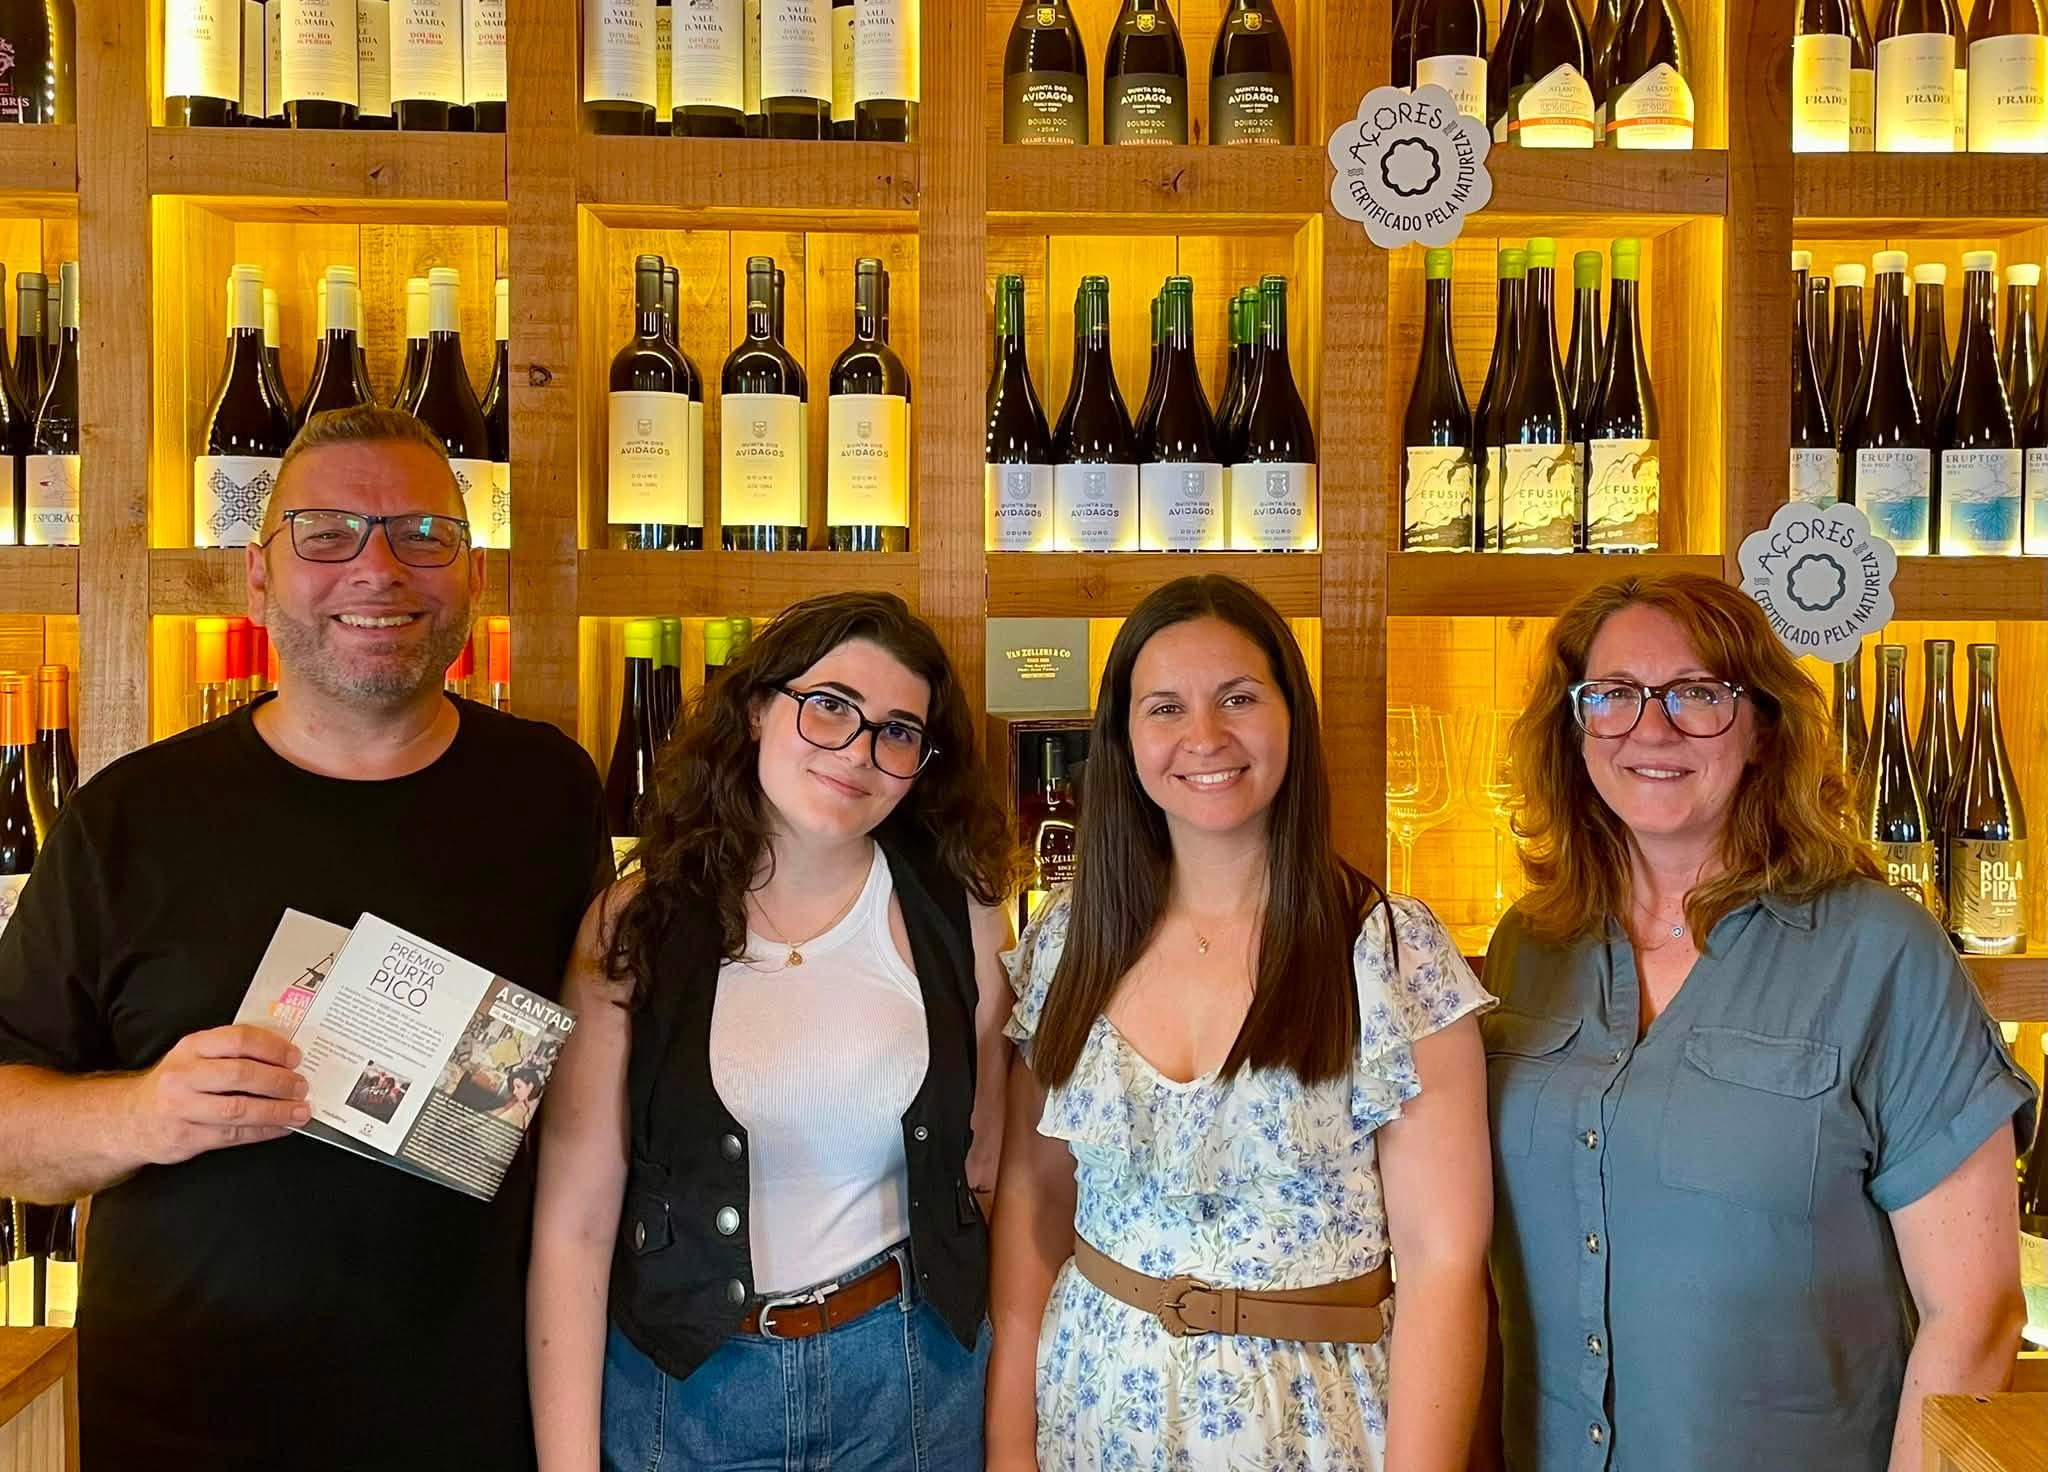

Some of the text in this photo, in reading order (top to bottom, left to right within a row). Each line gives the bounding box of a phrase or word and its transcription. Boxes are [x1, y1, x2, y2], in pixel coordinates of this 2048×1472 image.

[304, 19, 335, 27] MARIA
[416, 18, 446, 27] MARIA
[614, 18, 644, 28] MARIA
[788, 16, 817, 24] MARIA
[868, 18, 895, 26] MARIA
[694, 24, 723, 32] MARIA
[1022, 92, 1074, 103] AVIDAGOS
[1121, 94, 1172, 104] AVIDAGOS
[1228, 93, 1279, 104] AVIDAGOS
[1805, 96, 1847, 104] FRADES
[1906, 94, 1951, 105] FRADES
[1997, 95, 2045, 106] FRADES
[1349, 102, 1442, 165] AÇORES
[1350, 129, 1475, 230] CERTIFICADO PELA NATUREZA
[621, 446, 670, 456] AVIDAGOS
[736, 448, 784, 458] AVIDAGOS
[841, 449, 888, 458] AVIDAGOS
[1862, 453, 1914, 462] ERUPTIO
[1946, 454, 1999, 463] ERUPTIO
[994, 509, 1042, 517] AVIDAGOS
[1071, 508, 1120, 517] AVIDAGOS
[1168, 508, 1214, 516] AVIDAGOS
[1254, 508, 1302, 516] AVIDAGOS
[1758, 518, 1855, 575] AÇORES
[1754, 552, 1880, 646] CERTIFICADO PELA NATUREZA
[1006, 650, 1020, 660] VAN
[1022, 648, 1052, 656] ZELLERS
[1888, 863, 1930, 882] ROLA
[1980, 860, 2022, 880] ROLA
[1981, 880, 2016, 900] PIPA
[389, 942, 444, 976] PRÉMIO
[382, 955, 434, 990] CURTA
[370, 969, 428, 1007] PICO
[496, 986, 509, 1002] A
